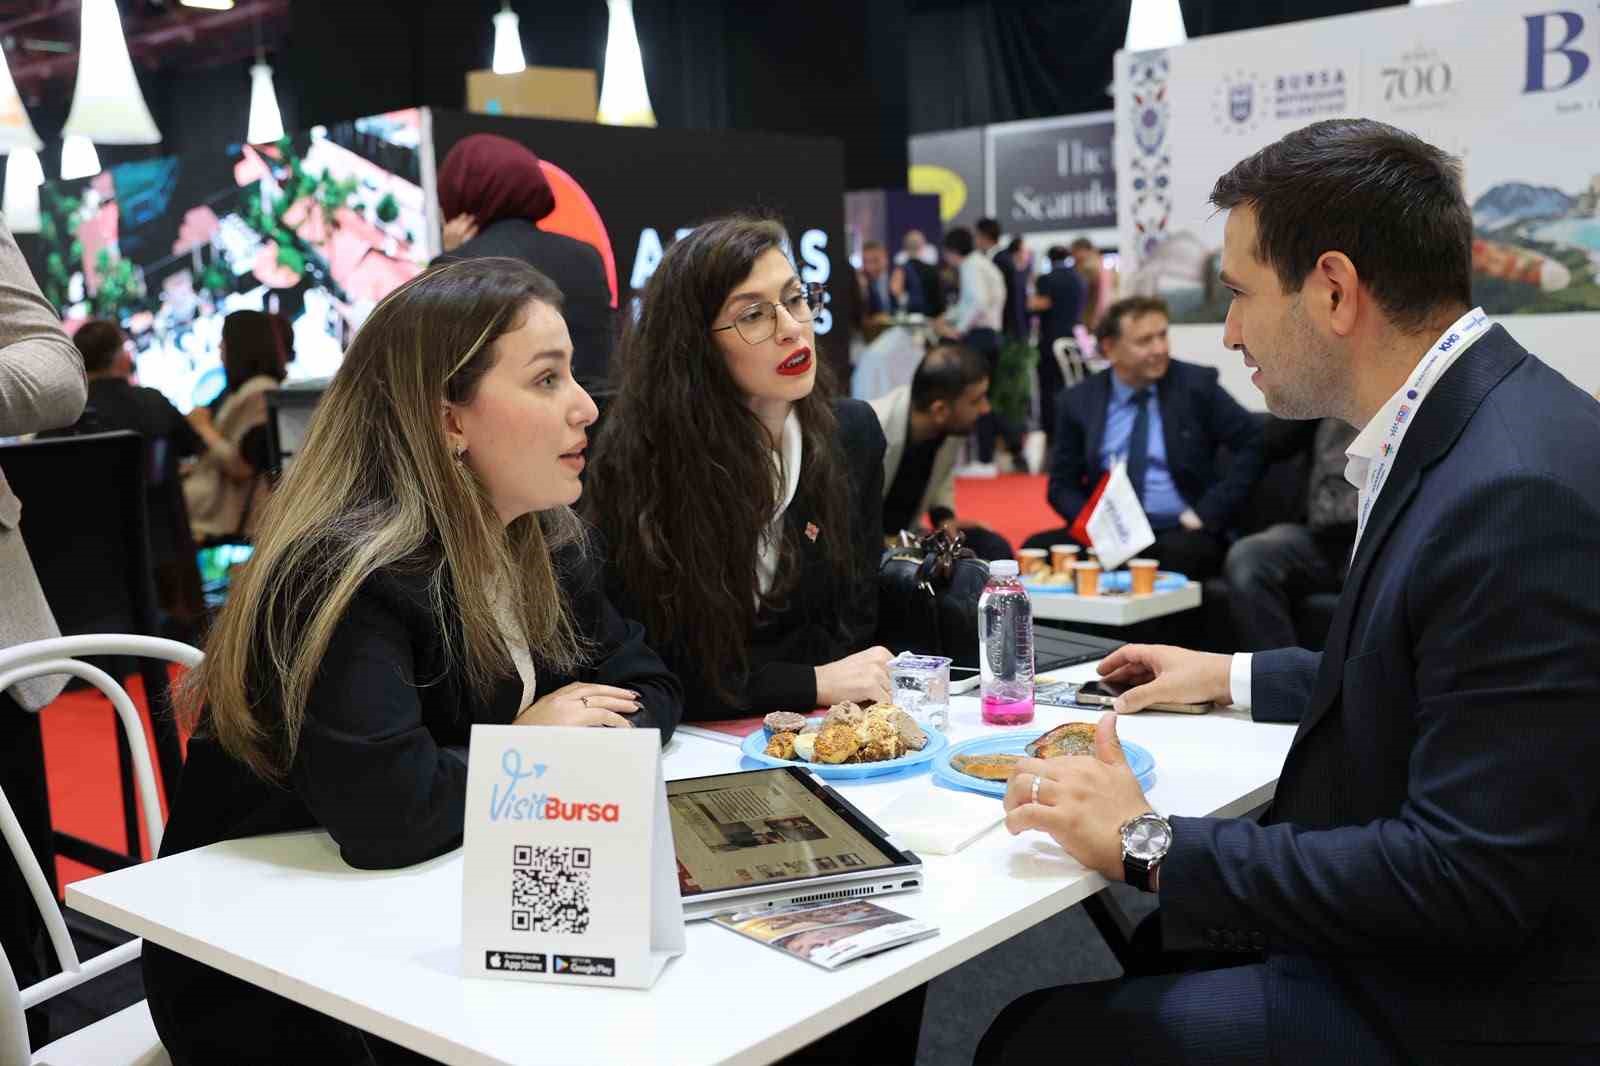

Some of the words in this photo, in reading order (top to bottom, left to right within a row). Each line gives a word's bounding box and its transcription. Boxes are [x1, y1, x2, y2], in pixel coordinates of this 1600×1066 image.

[1380, 62, 1453, 101] 700
[504, 959, 520, 970] App
[521, 960, 543, 970] Store
